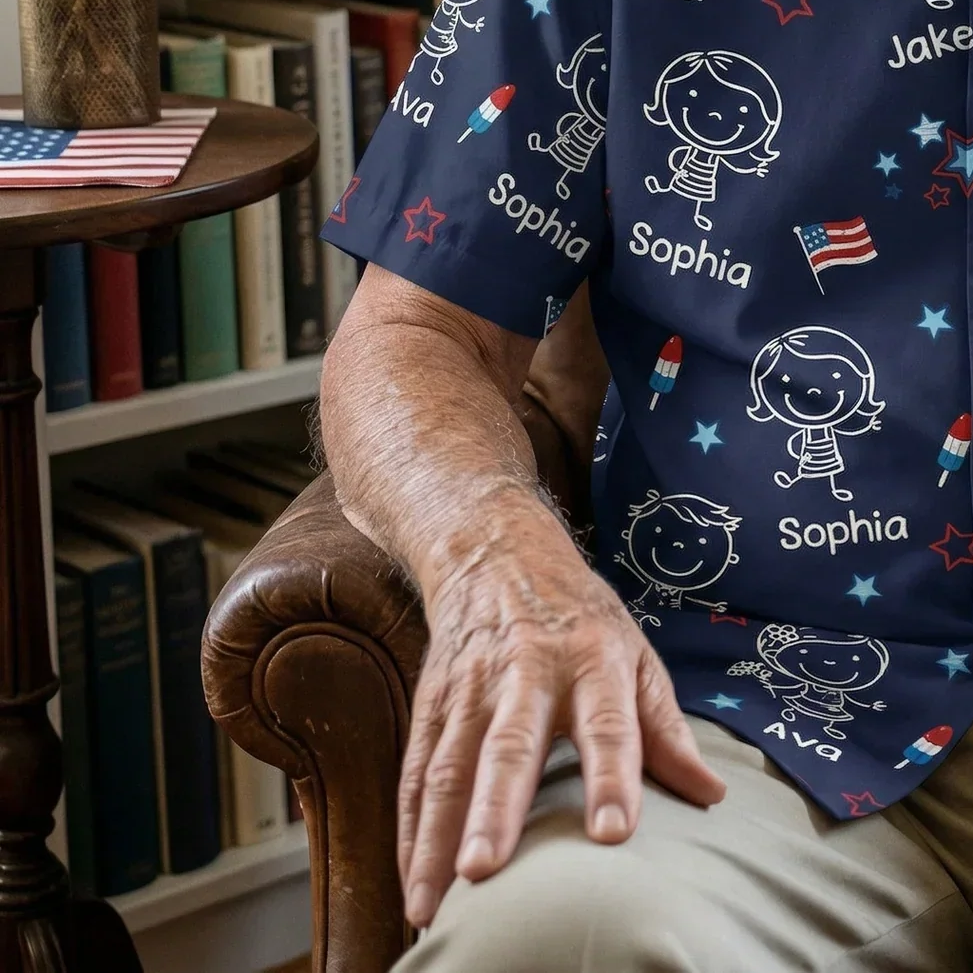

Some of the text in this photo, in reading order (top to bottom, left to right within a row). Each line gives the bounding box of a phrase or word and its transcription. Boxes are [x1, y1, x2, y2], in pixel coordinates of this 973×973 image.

[488, 173, 591, 263] Sophia
[629, 221, 752, 289] Sophia
[778, 509, 909, 556] Sophia
[762, 721, 843, 762] Ava
